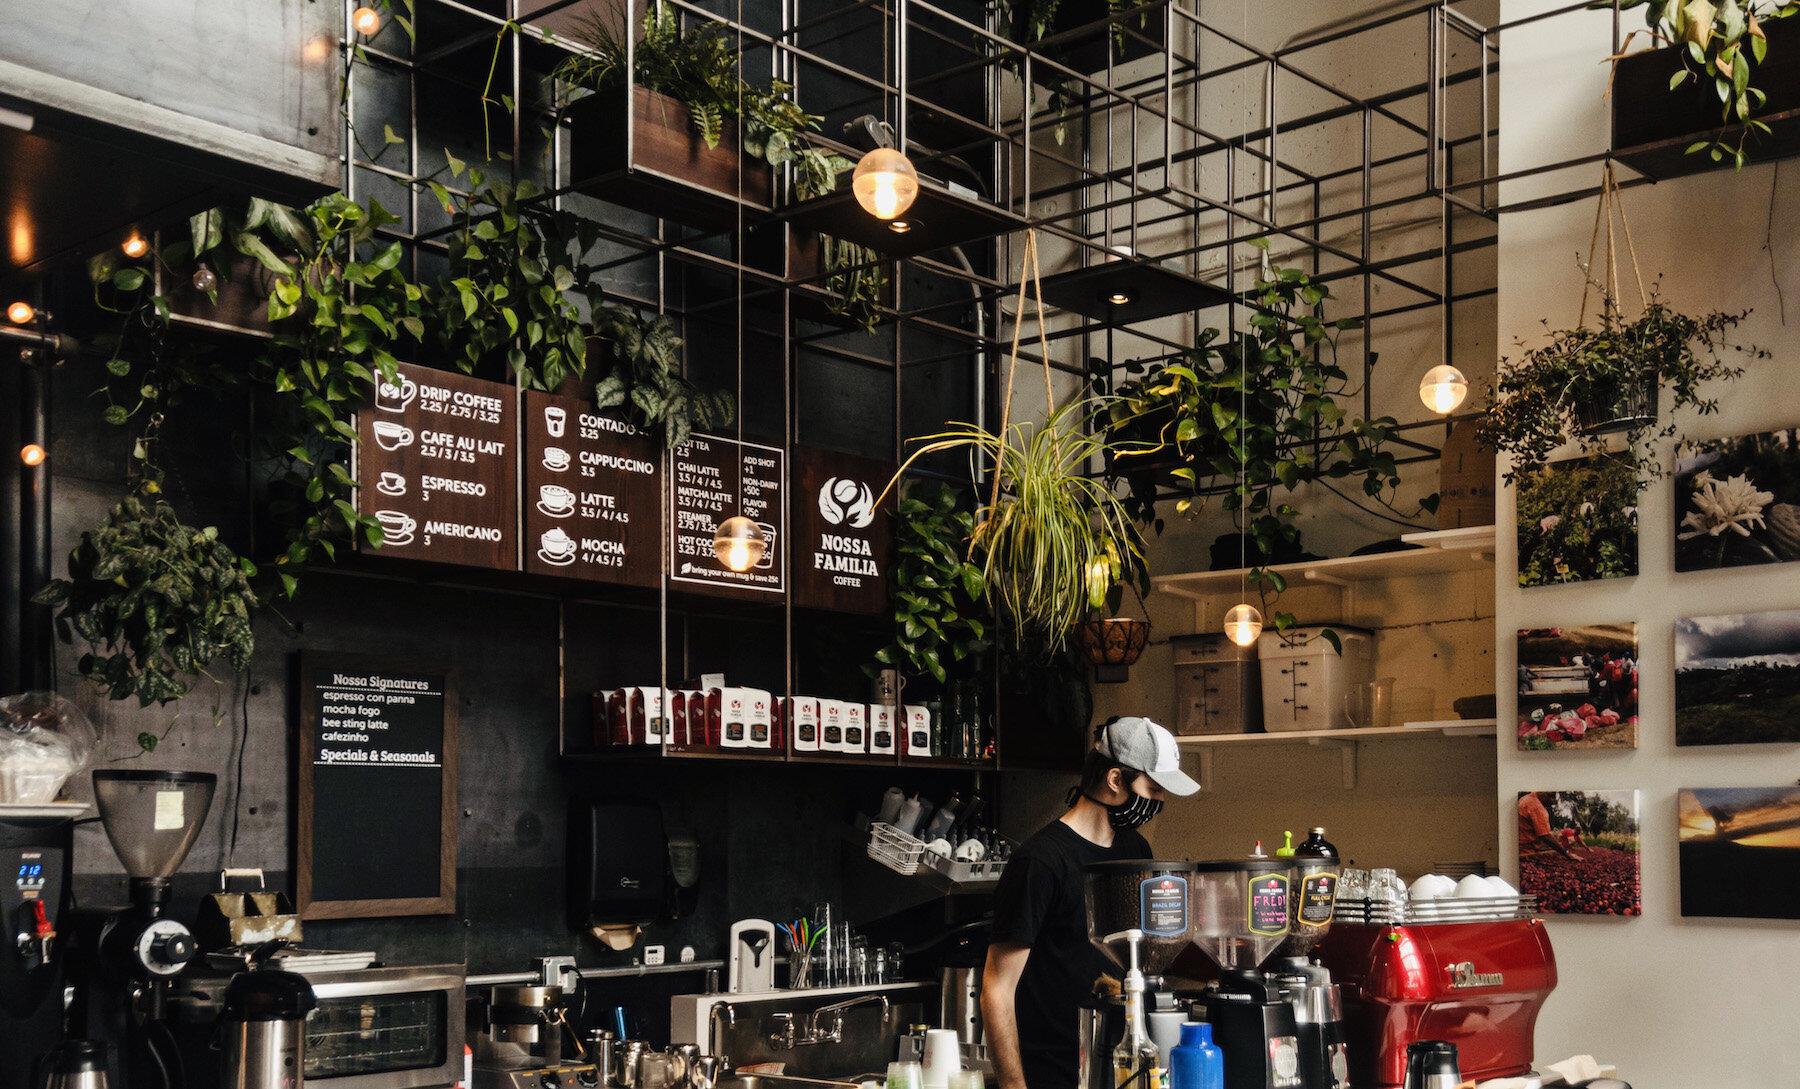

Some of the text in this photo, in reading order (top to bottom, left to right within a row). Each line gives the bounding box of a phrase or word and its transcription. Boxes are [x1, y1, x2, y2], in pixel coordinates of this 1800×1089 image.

[420, 385, 503, 413] DRIP COFFEE
[420, 399, 442, 413] 2.25
[450, 404, 471, 419] 2.75
[479, 410, 500, 424] 3.25
[579, 414, 636, 435] CORTADO
[580, 428, 599, 439] 3.25
[421, 430, 505, 456] CAFE AU LAIT
[695, 440, 710, 452] TEA
[421, 445, 436, 457] 2.5
[445, 448, 451, 460] 3
[460, 451, 475, 463] 3.5
[743, 455, 776, 468] ADD SHOT
[579, 451, 654, 475] CAPPUCCINO
[677, 462, 720, 477] CHAI LATTE
[581, 466, 595, 477] 3.5
[421, 475, 486, 497] ESPRESSO
[742, 477, 778, 490] NON-DAIRY
[422, 490, 429, 501] 3
[581, 492, 615, 509] LATTE
[677, 486, 733, 503] MATCHA LATTE
[743, 498, 767, 508] FLAVOR
[581, 507, 595, 518] 3.5
[602, 510, 608, 519] 4
[615, 512, 629, 524] 4.5
[677, 510, 711, 523] STEAMER
[424, 521, 502, 542] AMERICANO
[424, 535, 431, 546] 3
[581, 538, 625, 555] MOCHA
[677, 535, 714, 548] HOT COC
[821, 533, 872, 557] NOSSA
[582, 552, 589, 563] 4
[596, 554, 610, 565] 4.5
[616, 556, 623, 567] 5
[814, 552, 879, 577] FAMILIA
[691, 565, 708, 576] bring
[708, 569, 722, 577] your
[833, 575, 861, 587] COFFEE
[333, 674, 429, 692] Nossa Signatures
[323, 691, 415, 704] espresso con panna
[322, 705, 380, 717] mocha fogo
[322, 717, 389, 731] bee sting latte
[321, 731, 369, 743] cafezinho
[320, 748, 436, 763] Specials & Seasonals
[19, 864, 42, 876] 212
